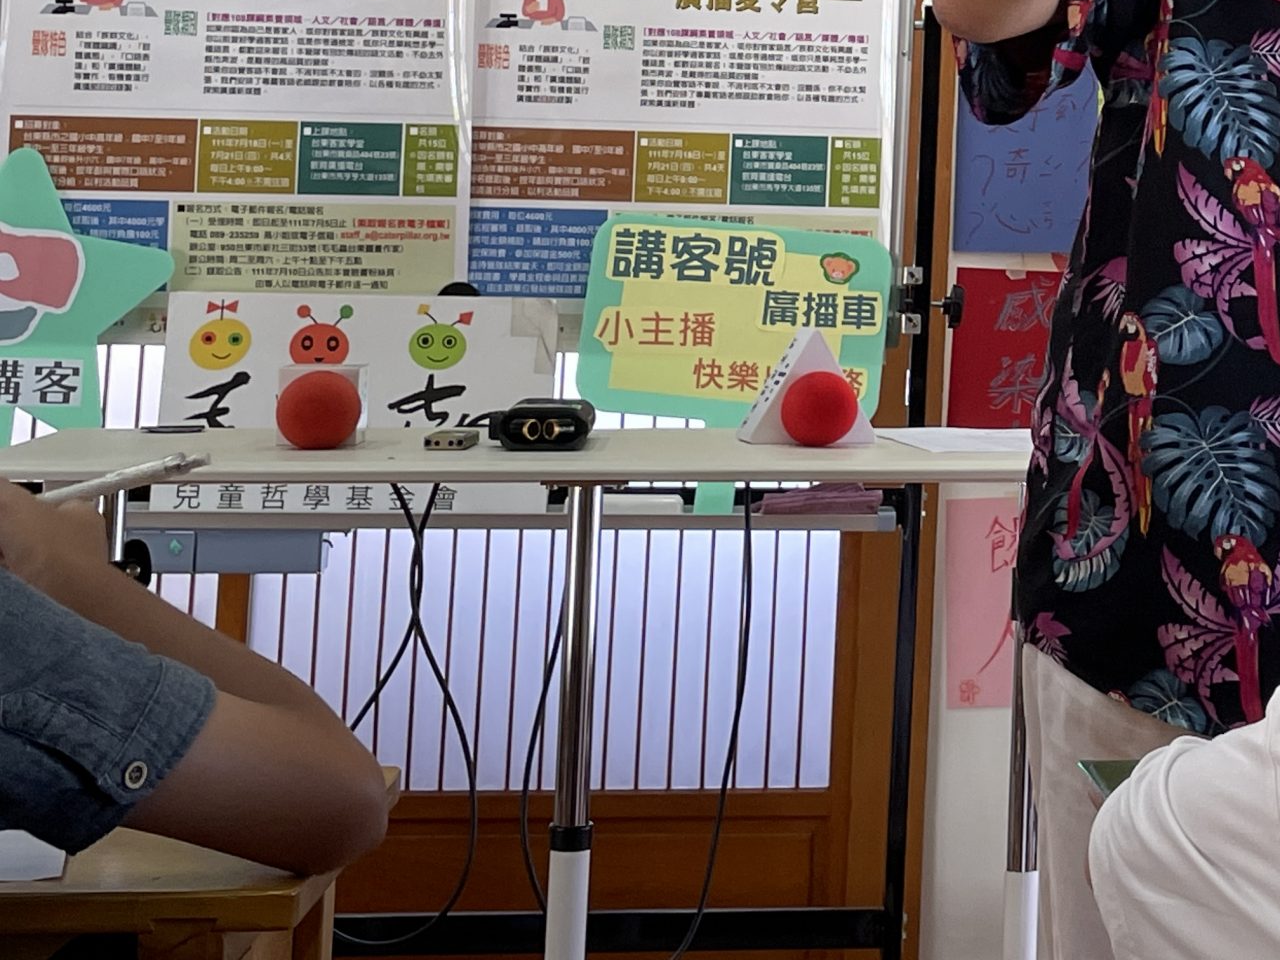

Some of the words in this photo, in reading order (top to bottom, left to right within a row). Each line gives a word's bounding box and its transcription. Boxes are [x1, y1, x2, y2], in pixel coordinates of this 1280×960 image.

[340, 232, 450, 243] staff_a@caterpillar.org.tw
[612, 229, 777, 286] 講客號
[598, 310, 716, 349] 小主播
[762, 290, 878, 330] 廣播車
[173, 484, 458, 512] 兒童哲學基金會
